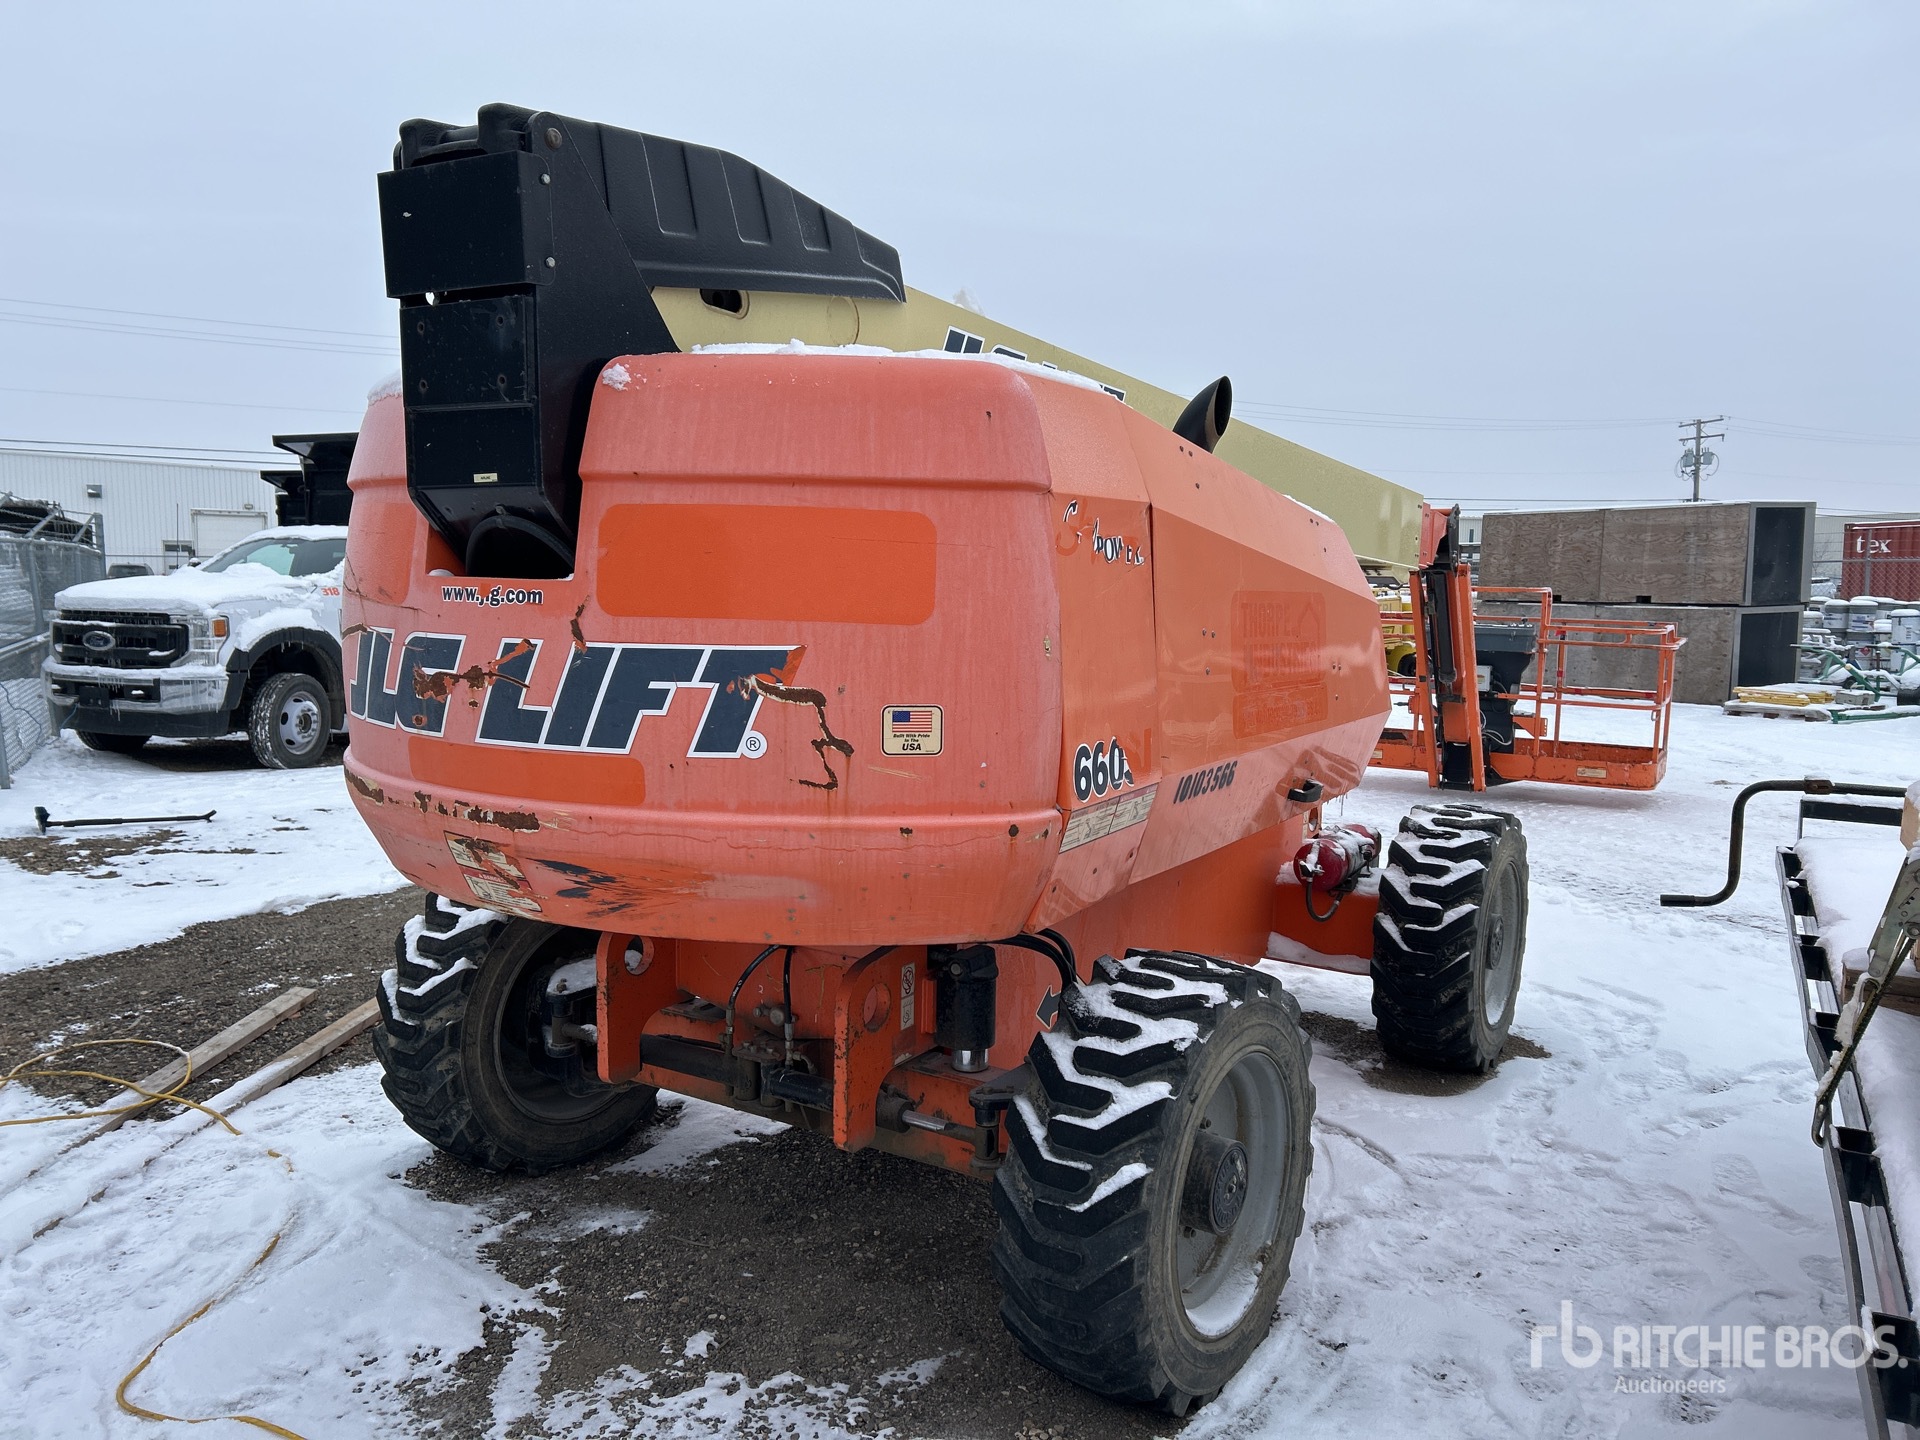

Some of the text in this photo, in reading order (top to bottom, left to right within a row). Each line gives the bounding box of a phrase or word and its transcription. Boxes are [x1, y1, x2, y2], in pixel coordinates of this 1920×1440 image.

[1856, 535, 1892, 554] tex
[320, 586, 340, 597] 318
[349, 626, 806, 759] JLG LIFT
[902, 743, 921, 751] USA
[1173, 760, 1238, 805] 10103566
